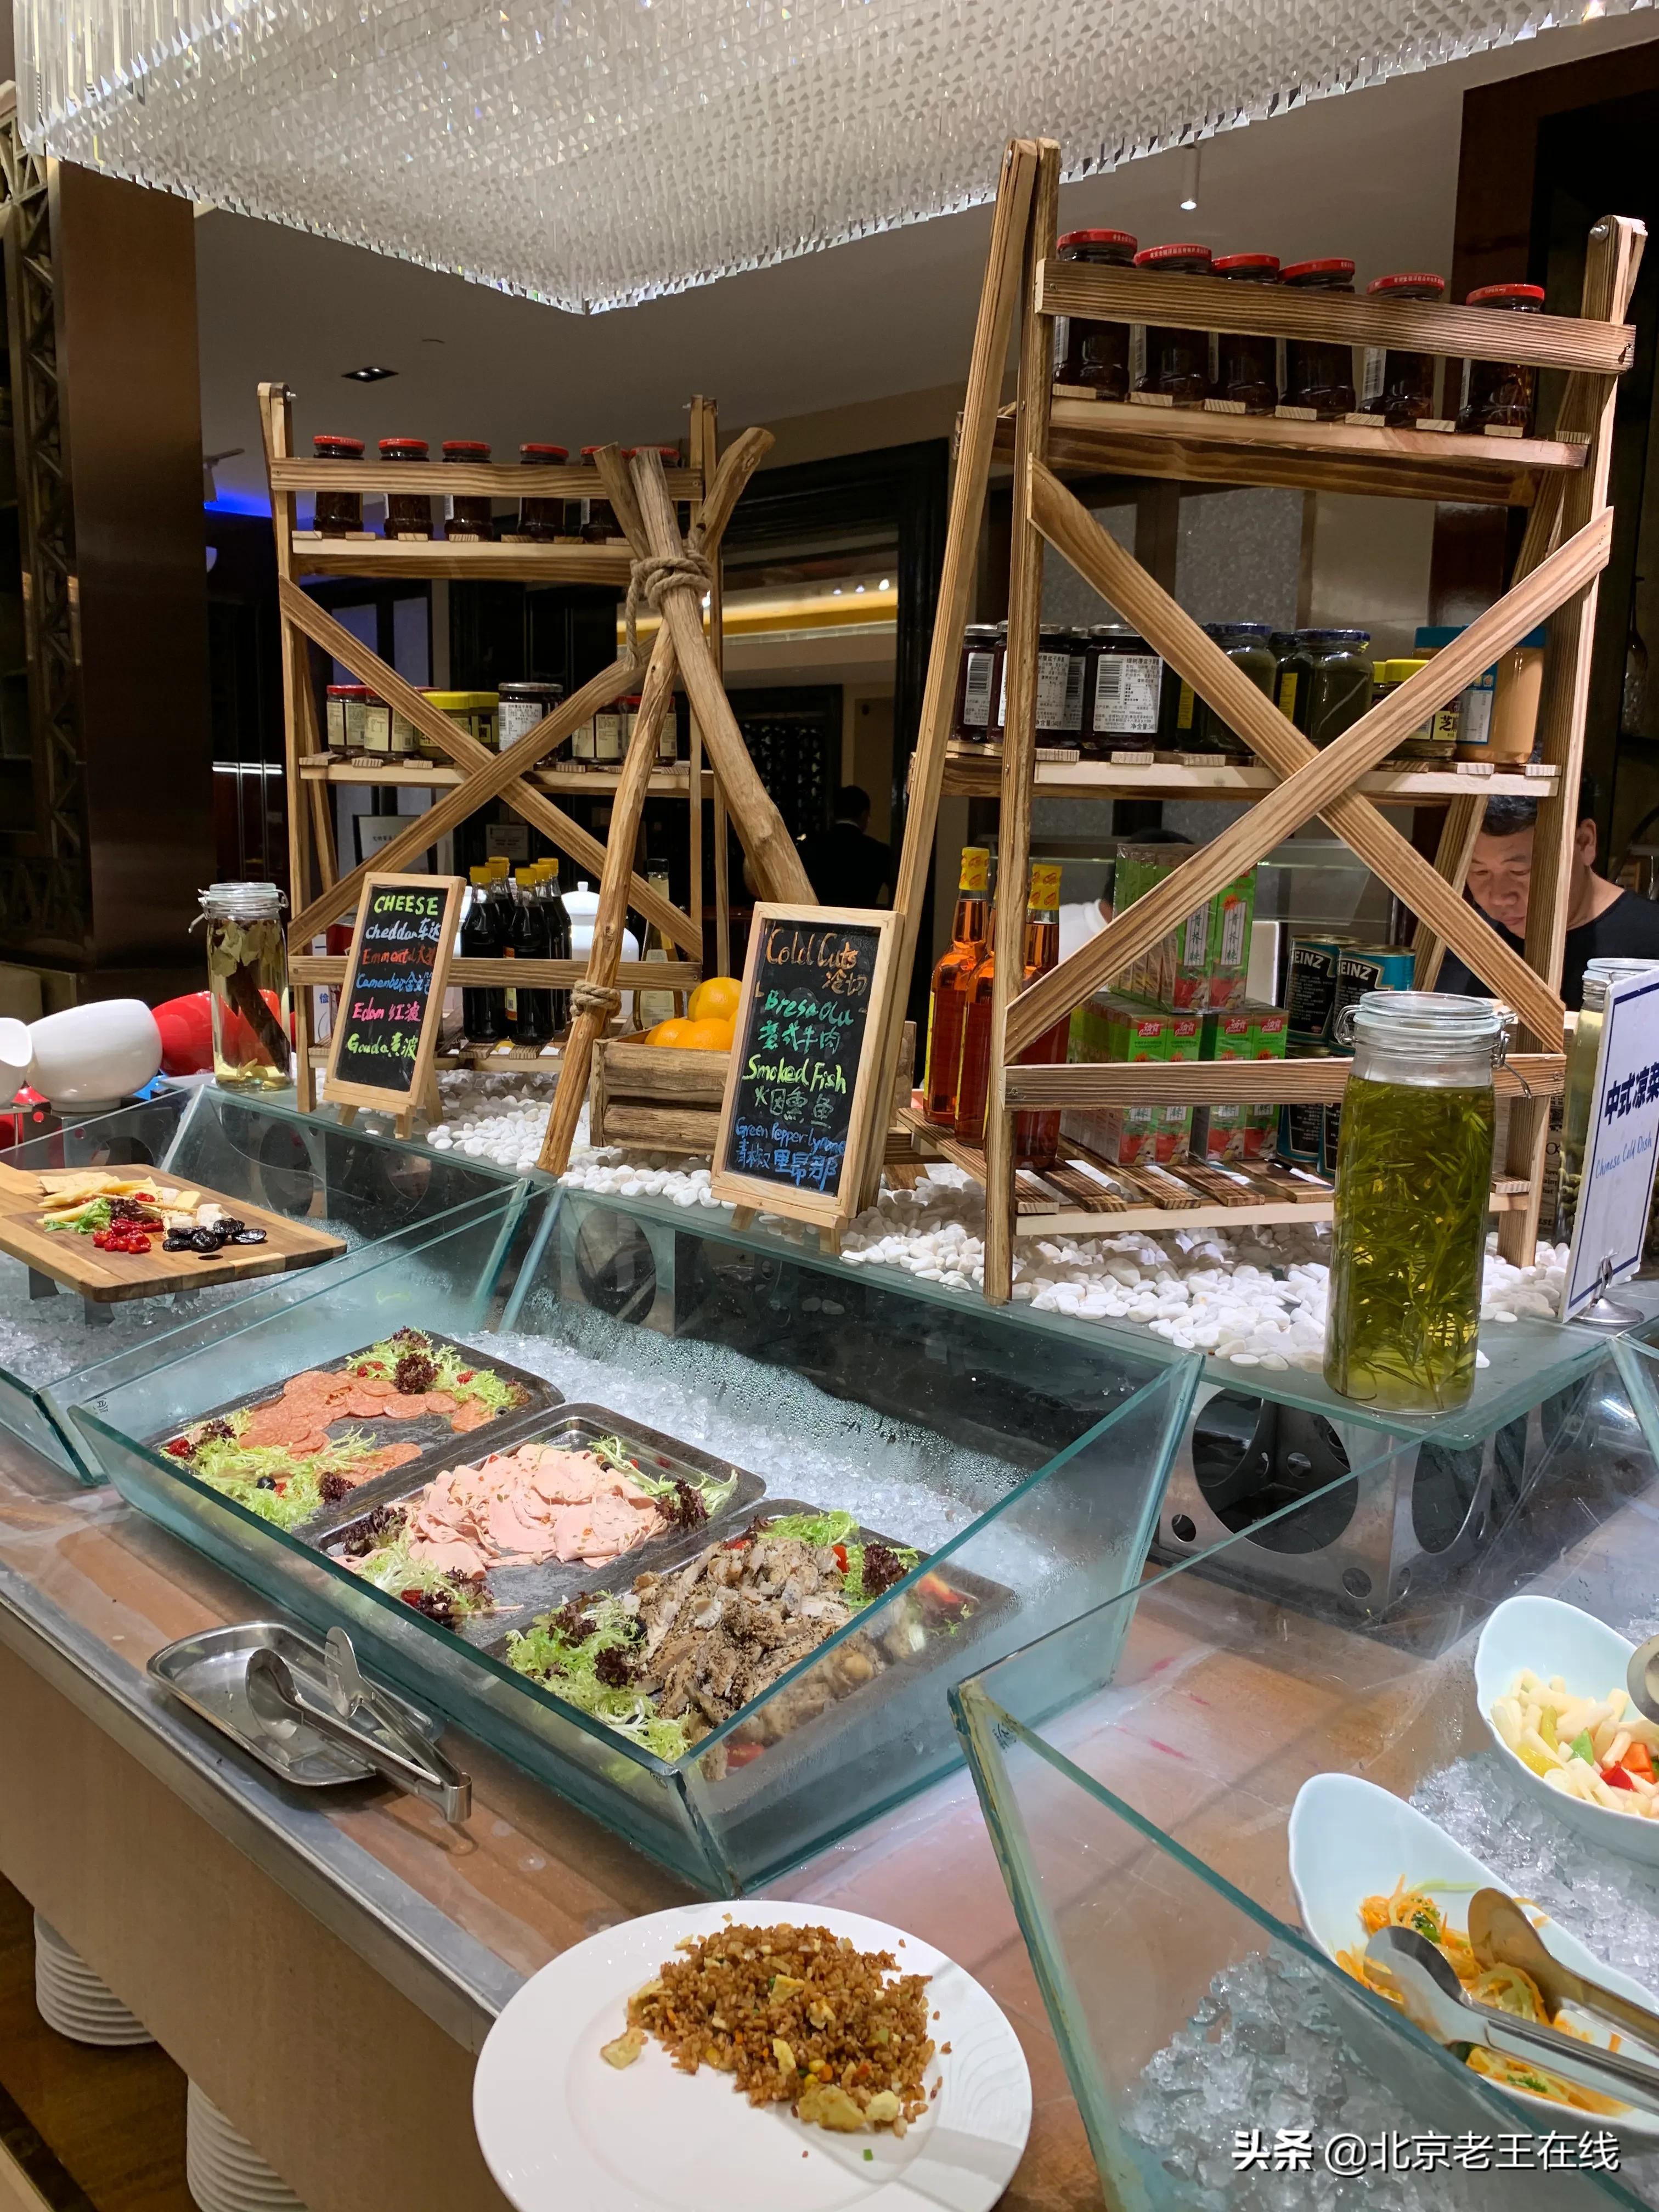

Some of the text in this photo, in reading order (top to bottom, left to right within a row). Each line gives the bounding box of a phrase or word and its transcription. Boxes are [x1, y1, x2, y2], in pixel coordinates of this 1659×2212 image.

[374, 895, 438, 916] CHEESE
[766, 928, 860, 970] Cold Cuts
[1291, 950, 1324, 969] EINZ
[821, 968, 868, 996] 冷切
[352, 996, 421, 1022] Edam 红波
[347, 1033, 389, 1054] Gouda
[758, 1020, 841, 1055] 意式牛肉
[742, 1053, 847, 1094] Smoked Fish
[1604, 1062, 1659, 1126] 中式凉菜
[735, 1116, 768, 1139] Green
[735, 1138, 838, 1192] 青椒里昂那
[1595, 1131, 1652, 1179] Chinese Cold Dish
